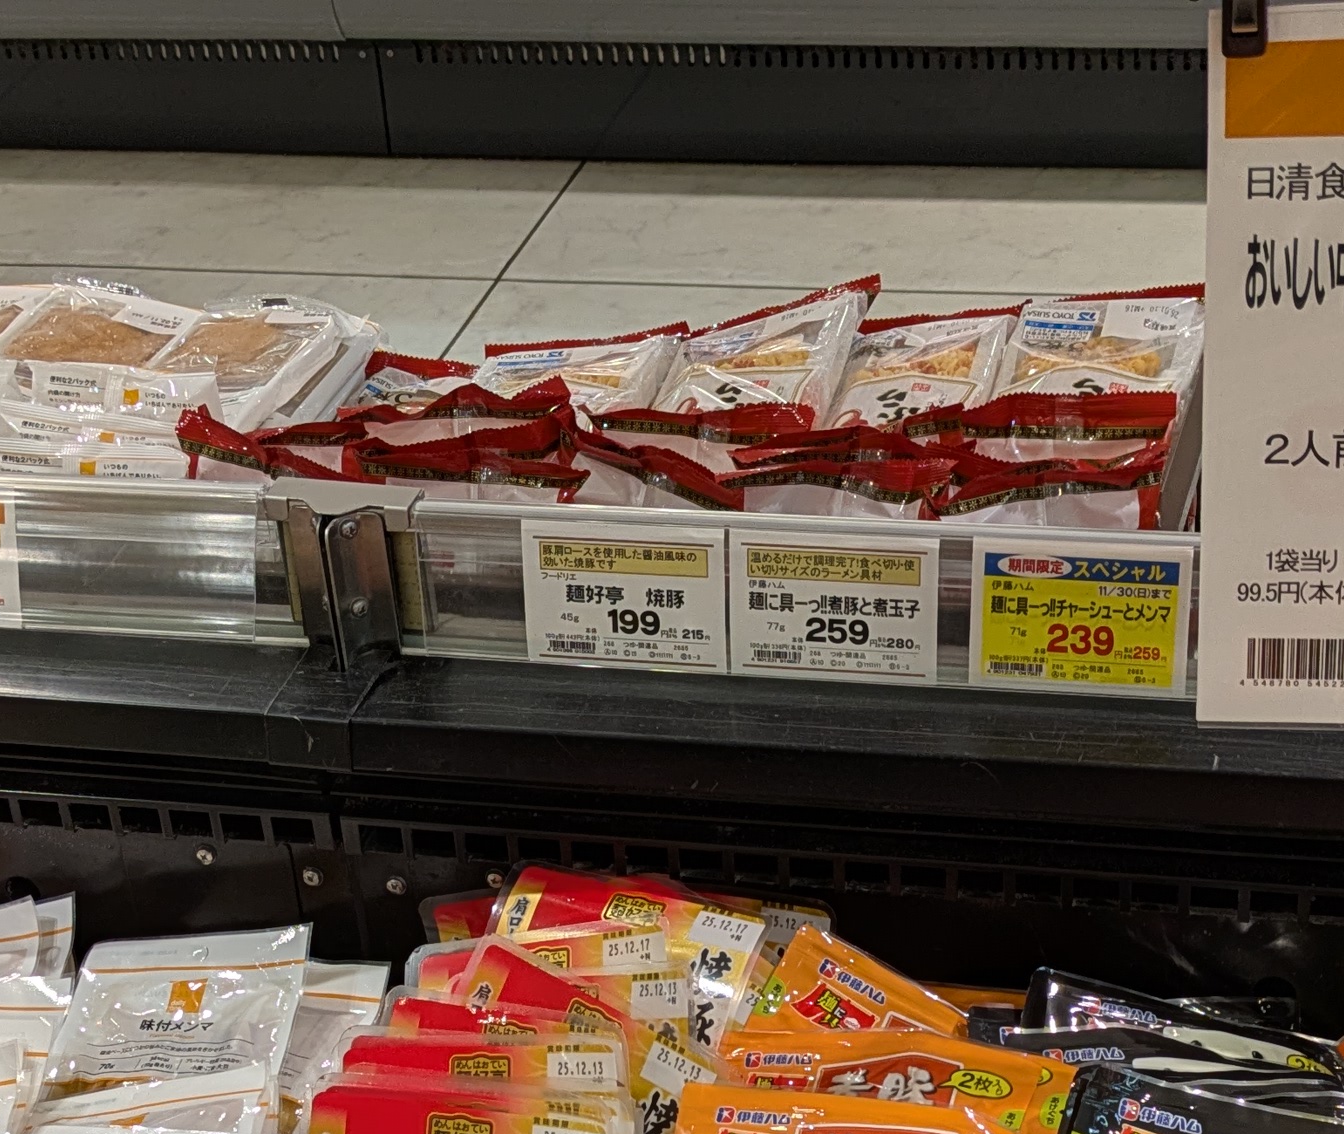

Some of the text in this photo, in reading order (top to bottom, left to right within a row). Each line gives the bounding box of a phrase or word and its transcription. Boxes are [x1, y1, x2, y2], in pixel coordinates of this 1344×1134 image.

[543, 557, 616, 570] 効いた焼豚です
[1008, 559, 1166, 581] 期間限定 スペシャル
[1265, 550, 1338, 574] 1袋当り
[541, 572, 576, 581] フードリエ
[750, 566, 882, 580] い切りサイズのラーメン具材
[749, 580, 785, 589] 伊藤ハム
[992, 581, 1034, 591] 伊藤ハム
[566, 584, 684, 608] 麺好亭 焼豚
[560, 613, 579, 623] 45g
[608, 609, 660, 635] 199
[767, 622, 785, 632] 77g
[806, 618, 869, 645] 259
[1010, 627, 1026, 637] 71g
[1047, 623, 1114, 656] 239
[608, 938, 650, 956] 25.12.17
[140, 1019, 214, 1032] 味付メンマ
[557, 1061, 603, 1076] 25.12.13
[736, 1110, 791, 1125] 伊藤ハム
[1139, 1108, 1202, 1134] 伊藤ハム
